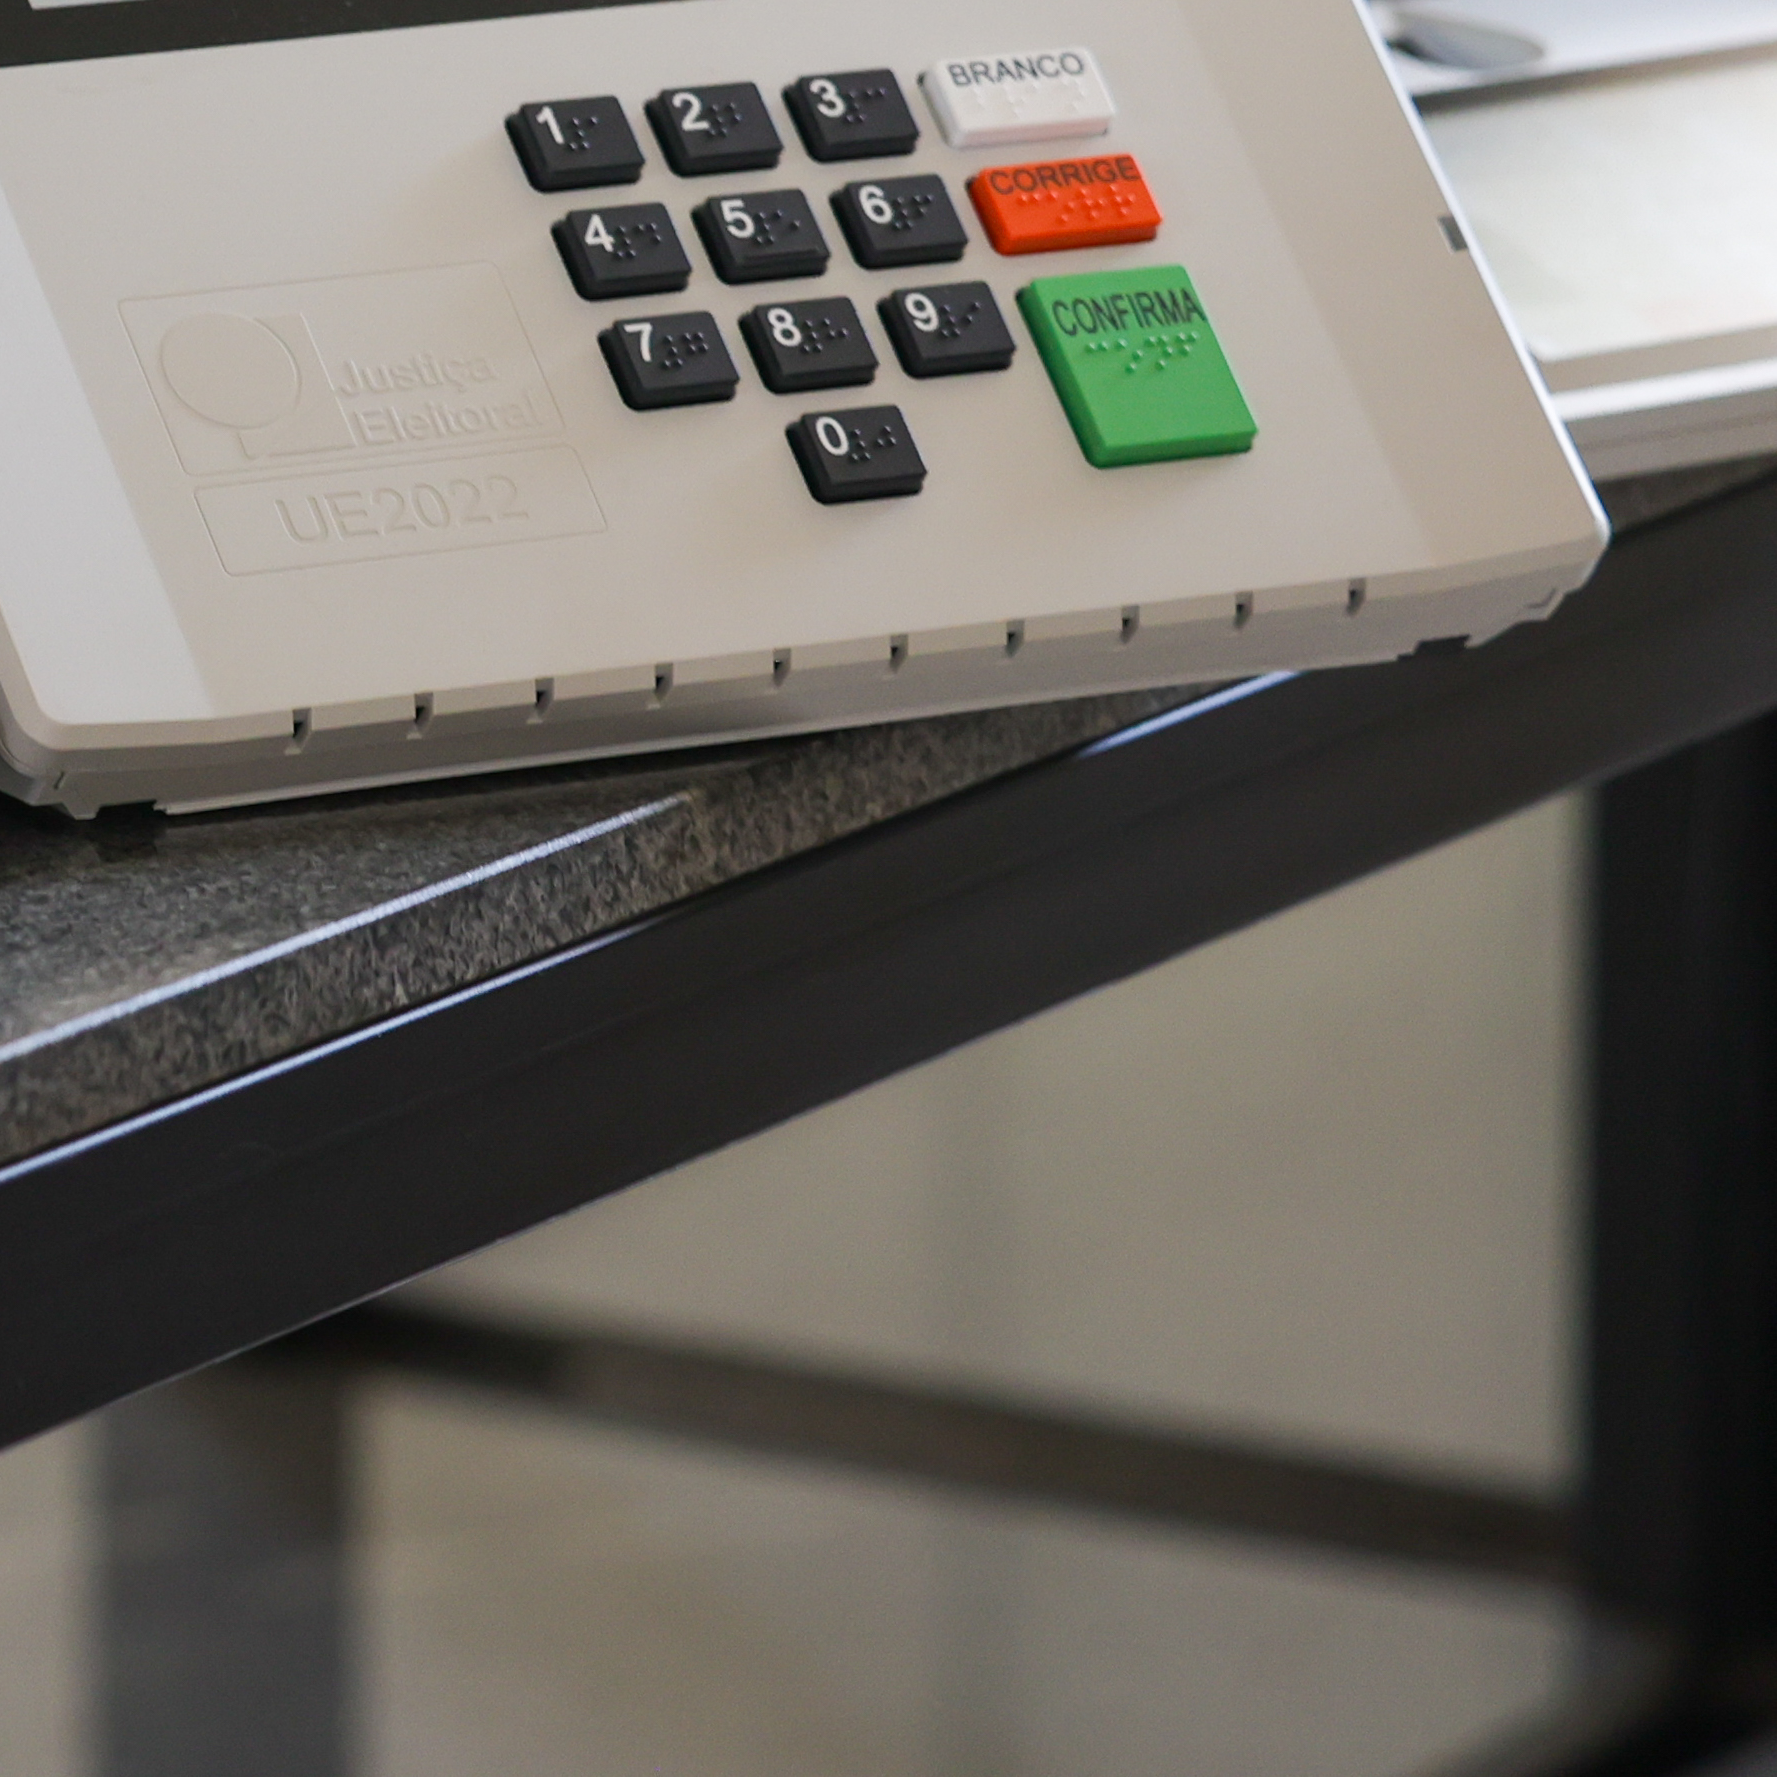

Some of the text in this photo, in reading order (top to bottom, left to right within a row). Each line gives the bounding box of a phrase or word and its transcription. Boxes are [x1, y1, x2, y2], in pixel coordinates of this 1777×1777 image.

[948, 52, 1085, 87] BRANCO
[671, 91, 710, 131] 2
[809, 79, 846, 118] 3
[536, 106, 565, 144] 1
[989, 155, 1142, 195] CORRIGE
[719, 199, 755, 238] 5
[858, 185, 894, 224] 6
[584, 214, 615, 252] 4
[767, 307, 802, 347] 8
[904, 292, 939, 332] 9
[1051, 286, 1210, 338] CONFIRMA
[623, 322, 653, 362] 7
[335, 352, 499, 397] Justiça
[352, 391, 544, 448] Eleitoral
[815, 416, 849, 456] 0
[274, 473, 530, 544] UE2022
